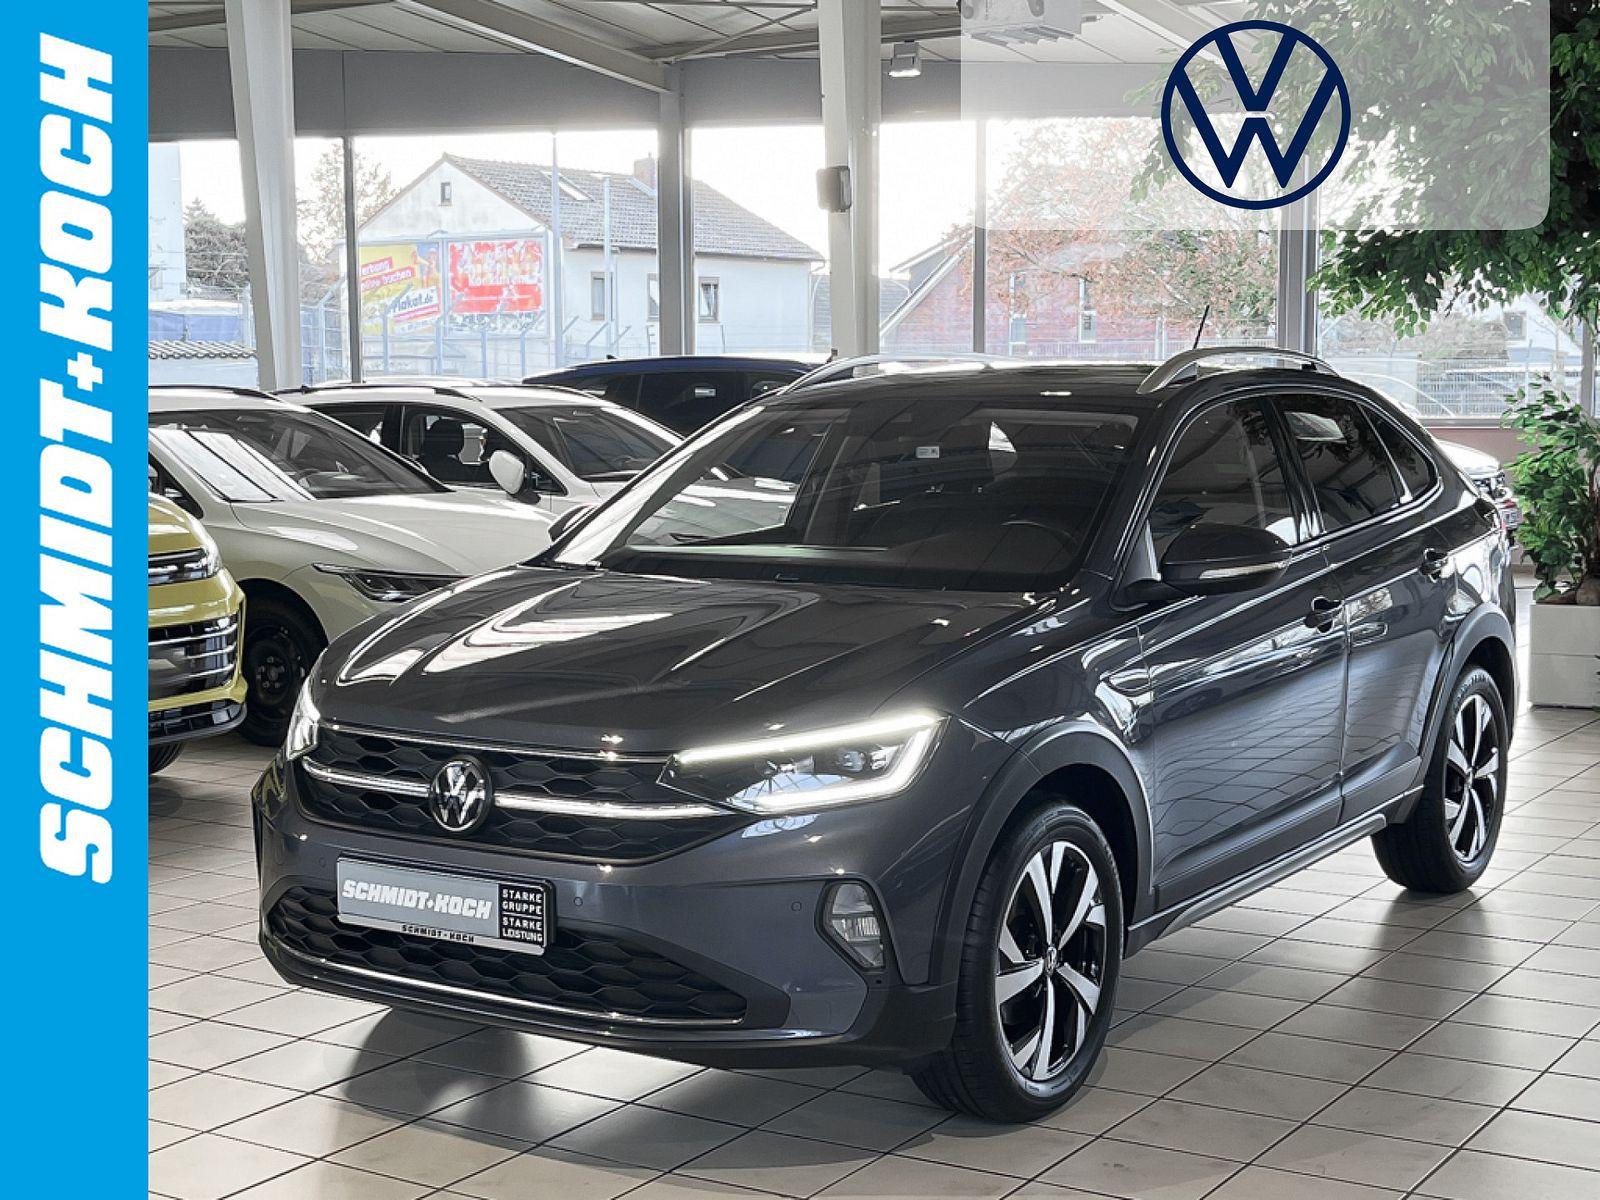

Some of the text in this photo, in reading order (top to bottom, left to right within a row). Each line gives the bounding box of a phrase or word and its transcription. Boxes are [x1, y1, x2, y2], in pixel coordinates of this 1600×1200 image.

[362, 261, 390, 275] erbung
[342, 879, 492, 919] SCHMIDT+KOCH
[501, 888, 543, 903] STARKE
[501, 900, 543, 915] GRUPPE
[501, 915, 543, 931] STARKE
[501, 927, 544, 942] LEISTUNG
